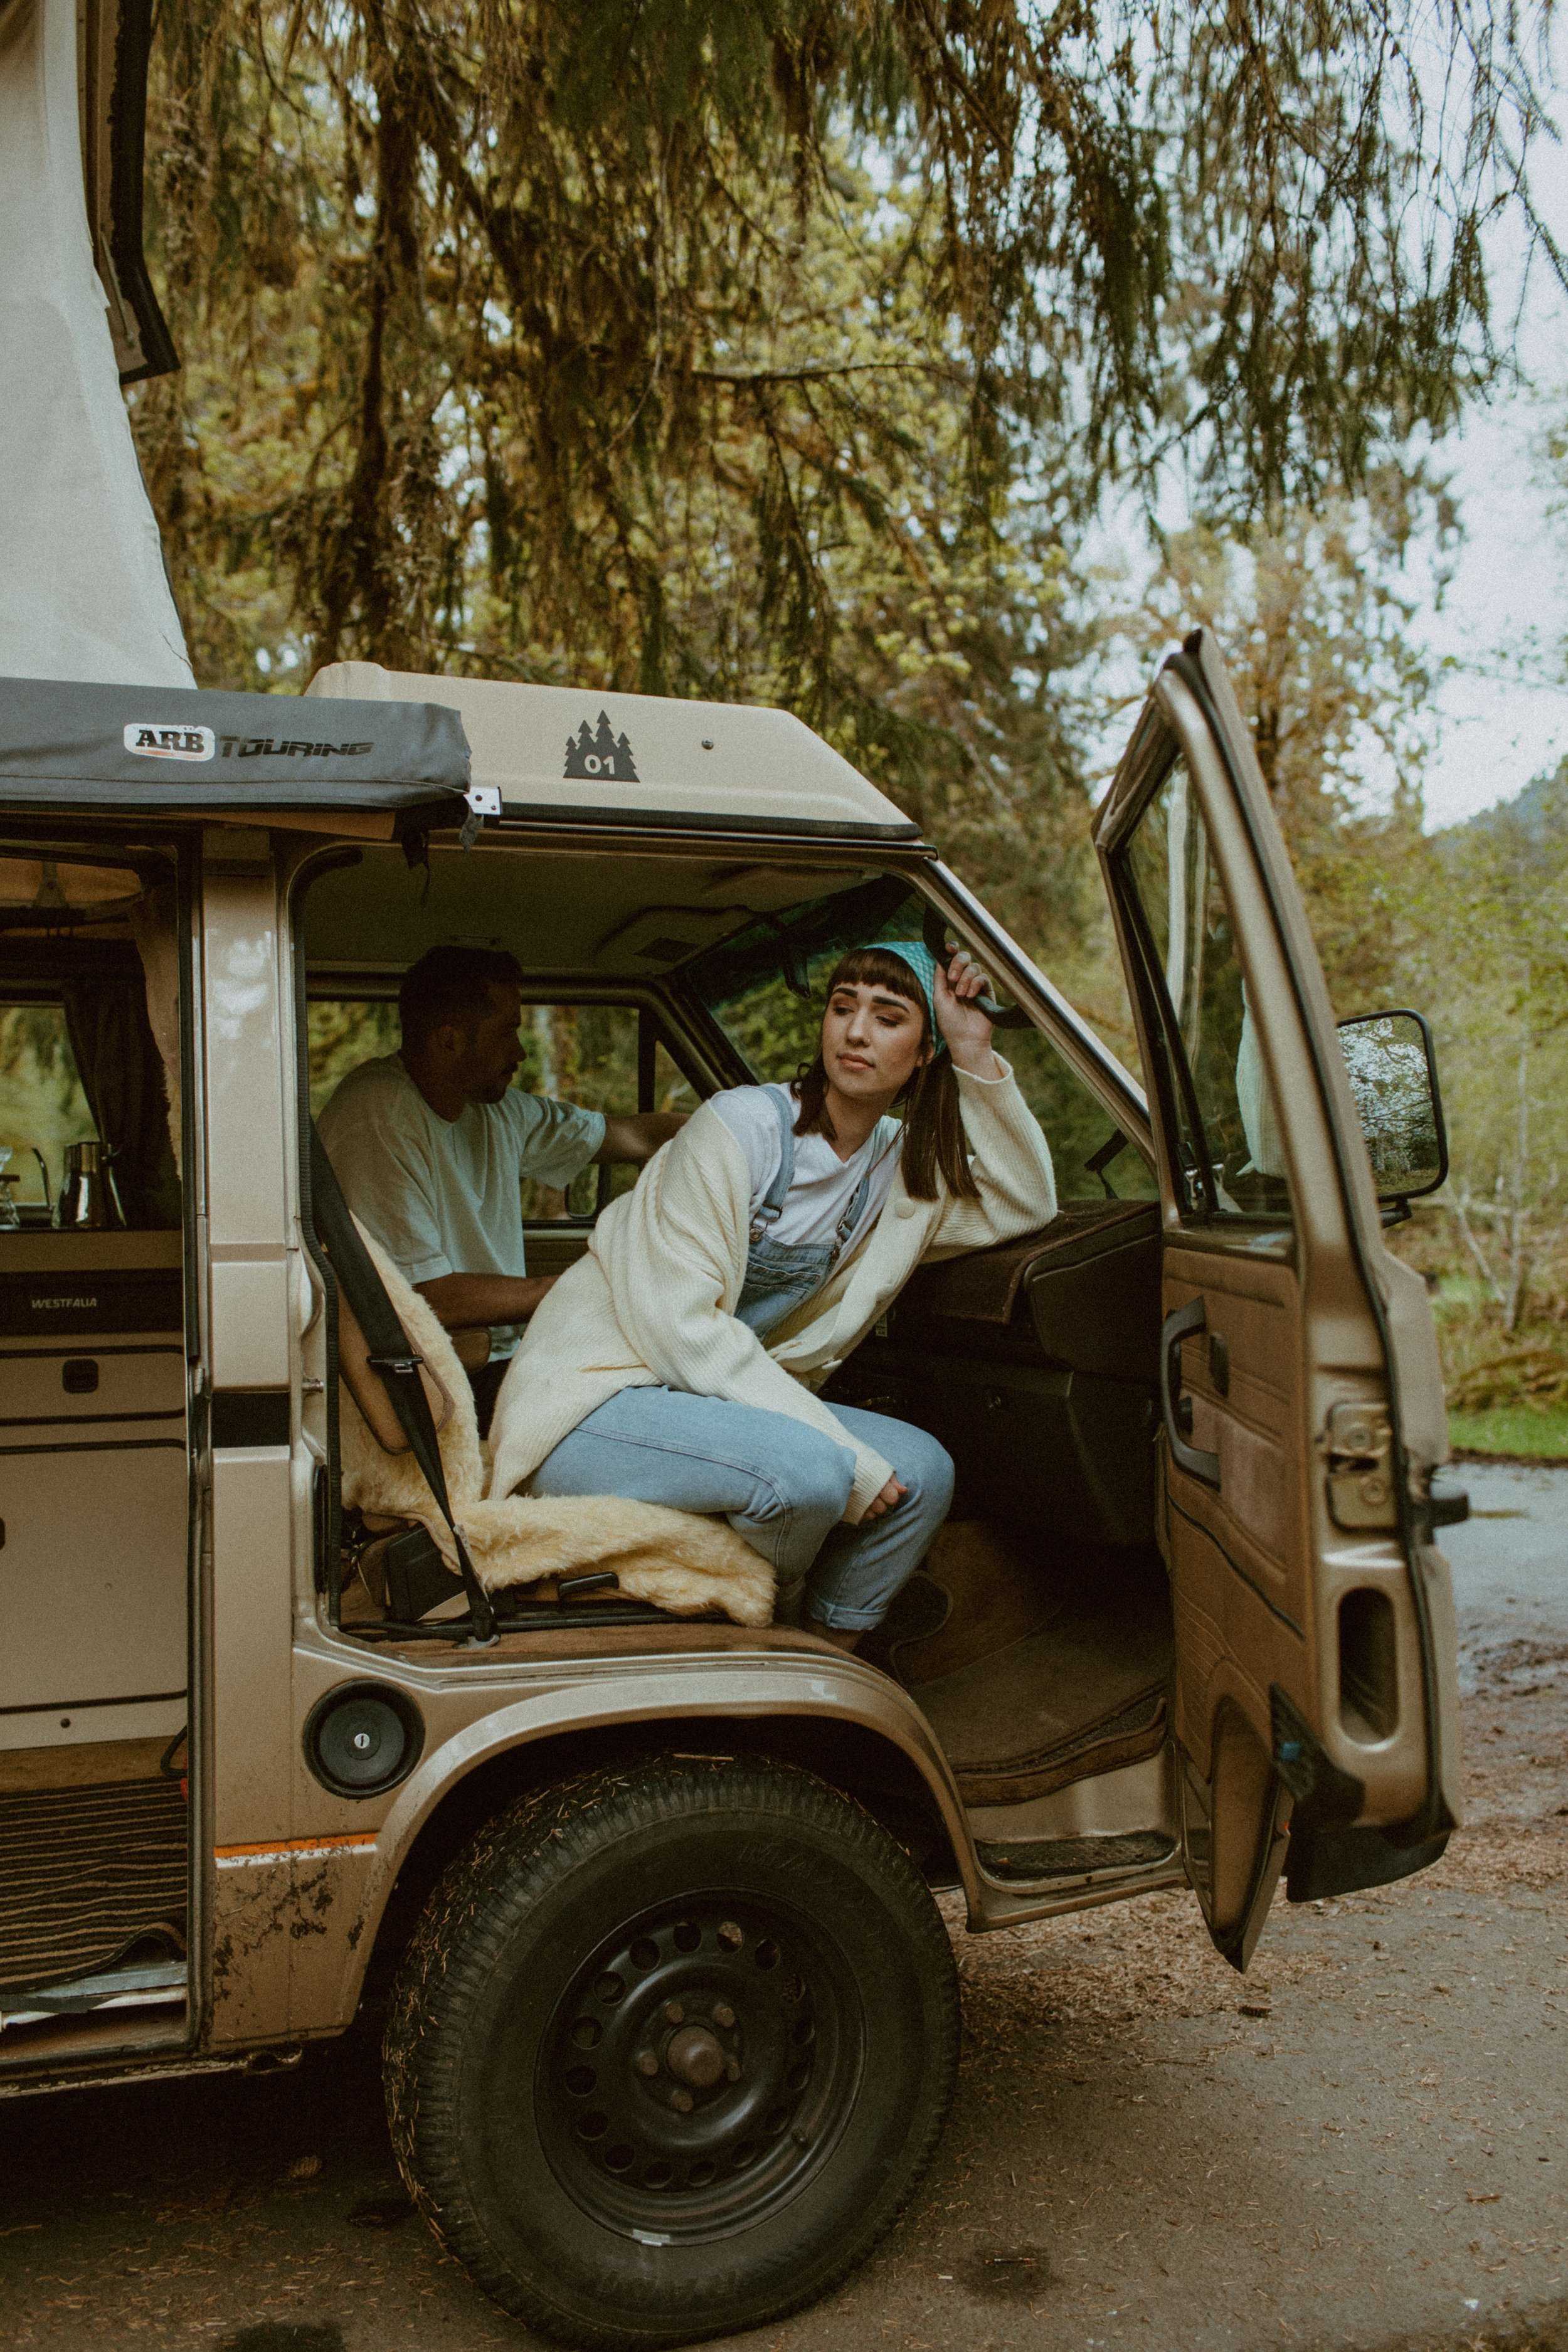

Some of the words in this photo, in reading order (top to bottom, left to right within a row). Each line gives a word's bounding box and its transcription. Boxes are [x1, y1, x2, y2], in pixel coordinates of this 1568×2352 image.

[136, 729, 205, 753] ARB
[220, 735, 375, 758] TOURING
[584, 754, 615, 775] 01
[31, 1297, 97, 1309] WESTFALIA
